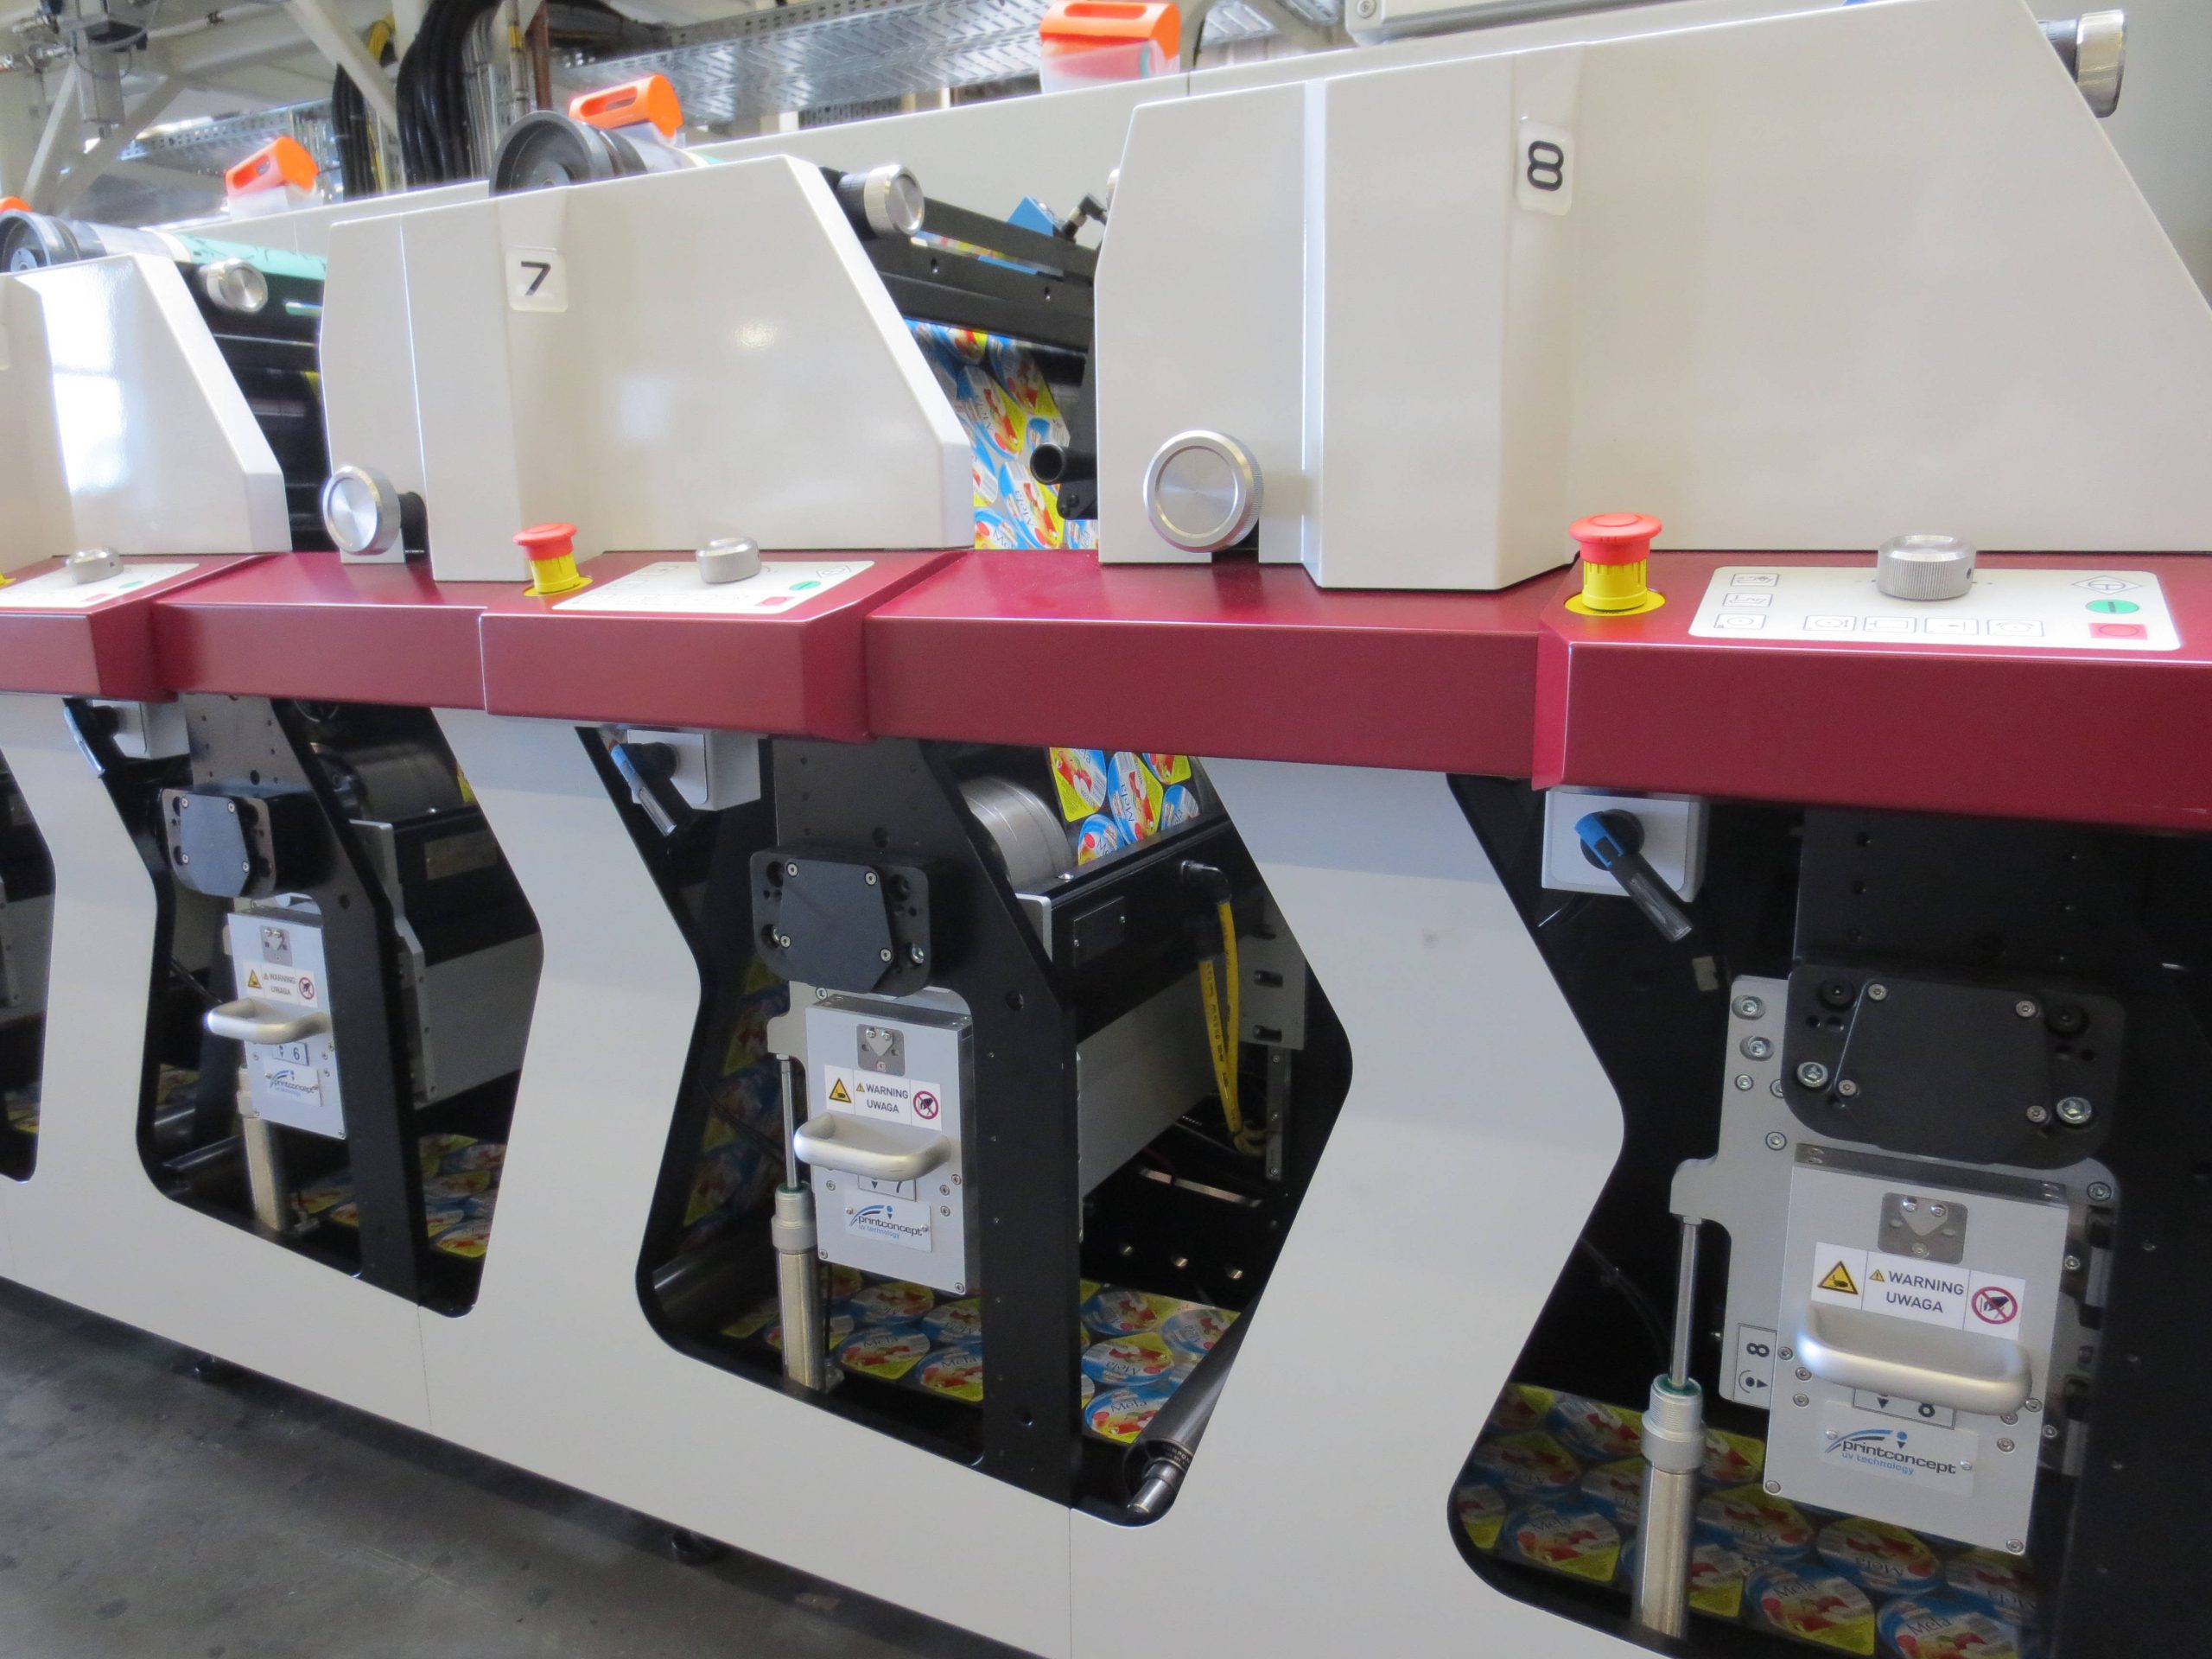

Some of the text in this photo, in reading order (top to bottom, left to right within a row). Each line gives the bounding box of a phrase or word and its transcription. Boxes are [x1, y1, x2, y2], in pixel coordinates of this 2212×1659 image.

[1528, 141, 1564, 191] 8
[521, 261, 551, 296] 7
[1014, 490, 1034, 526] Mela
[1121, 784, 1135, 822] Mela
[268, 973, 296, 984] WARNING
[292, 1046, 301, 1061] 6
[866, 1083, 909, 1099] WARNING
[867, 1099, 899, 1114] UWAGA
[858, 1216, 924, 1237] printconcept
[867, 1225, 900, 1239] technology
[1888, 1270, 1964, 1296] WARNING
[1886, 1291, 1943, 1313] UWAGA
[1745, 1343, 1770, 1357] 8
[1106, 1361, 1141, 1375] Mela
[1111, 1400, 1147, 1412] Mela
[1842, 1440, 1956, 1474] printconcept
[1857, 1454, 1915, 1476] technology
[1855, 1556, 1903, 1575] Mela
[1774, 1580, 1818, 1599] Mela
[1906, 1618, 1952, 1637] Mela
